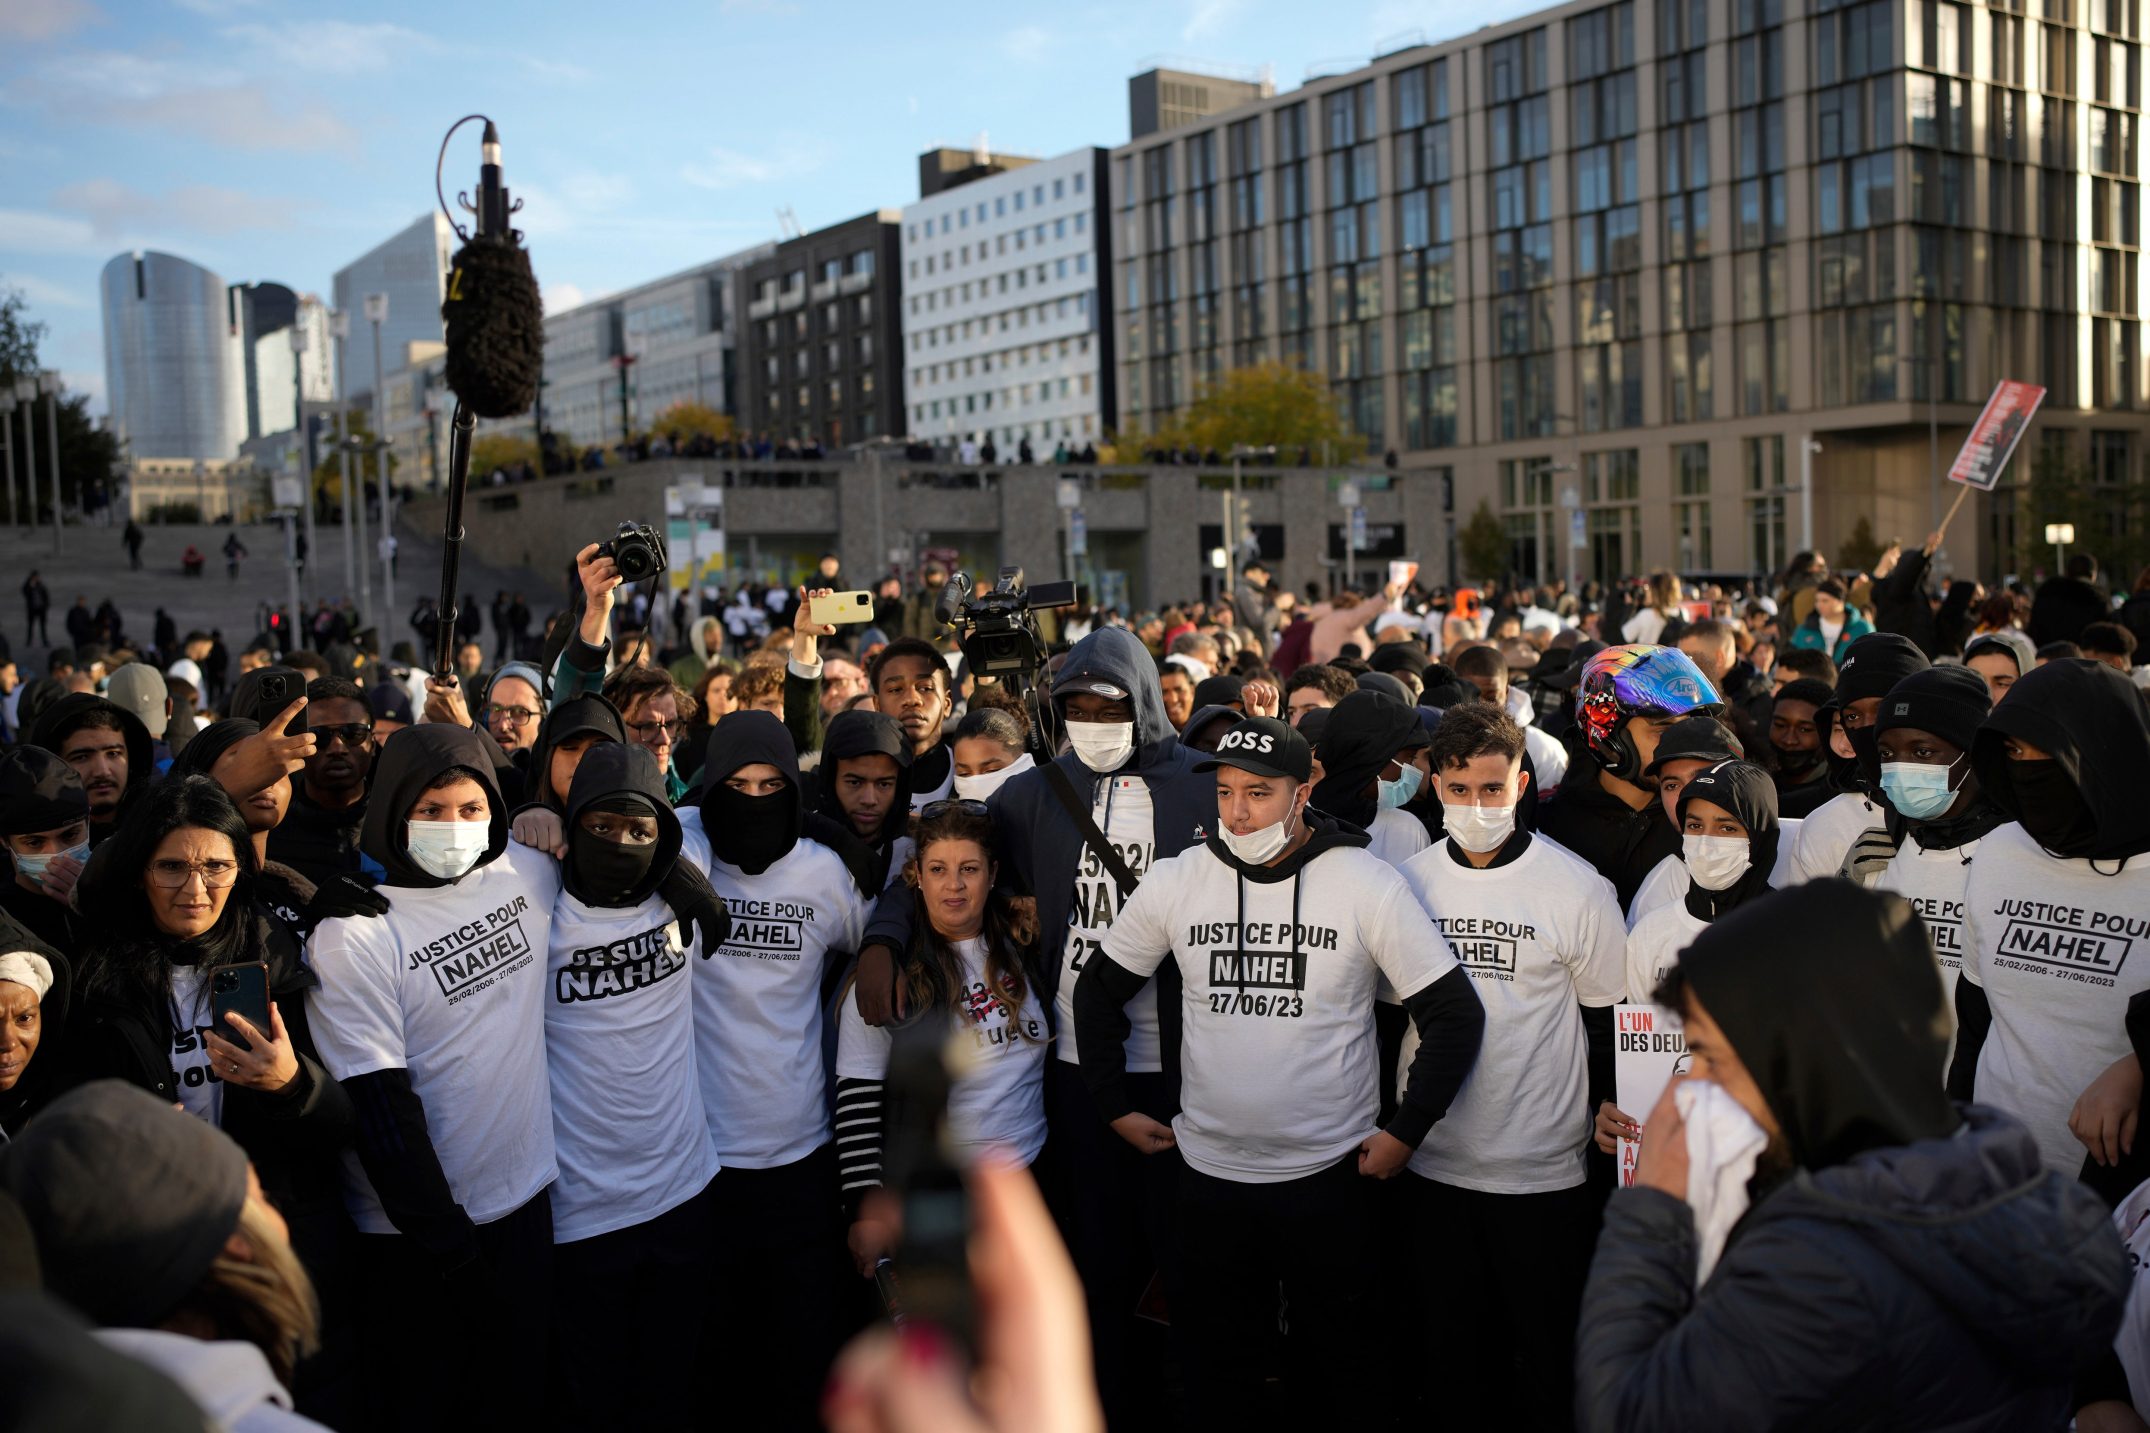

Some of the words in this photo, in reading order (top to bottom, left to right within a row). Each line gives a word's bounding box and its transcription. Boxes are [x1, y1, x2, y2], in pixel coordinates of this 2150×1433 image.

[1216, 730, 1275, 753] BOSS
[775, 903, 815, 922] POUR
[1994, 899, 2084, 927] JUSTICE
[409, 920, 488, 971] JUSTICE
[485, 895, 528, 929] POUR
[1187, 922, 1273, 947] JUSTCE
[1277, 923, 1338, 950] POUR
[1481, 919, 1536, 941] POUR
[442, 932, 522, 985] NAHEL
[573, 950, 605, 966] JE
[611, 926, 670, 966] SUIS
[758, 952, 800, 961] 27/06/2023
[1448, 942, 1507, 965] AHEL
[2009, 927, 2110, 966] NAHEL
[448, 979, 495, 1006] 25/02/2006
[499, 954, 534, 980] 27/06/2023
[560, 941, 684, 999] NAHEL
[1214, 955, 1300, 984] NAHEL
[1993, 957, 2048, 975] 25/02/2006
[2056, 969, 2115, 988] 27/06/2023
[1208, 993, 1303, 1018] 27/06/23
[1619, 1012, 1653, 1032] L'UN
[1620, 1033, 1649, 1052] DES
